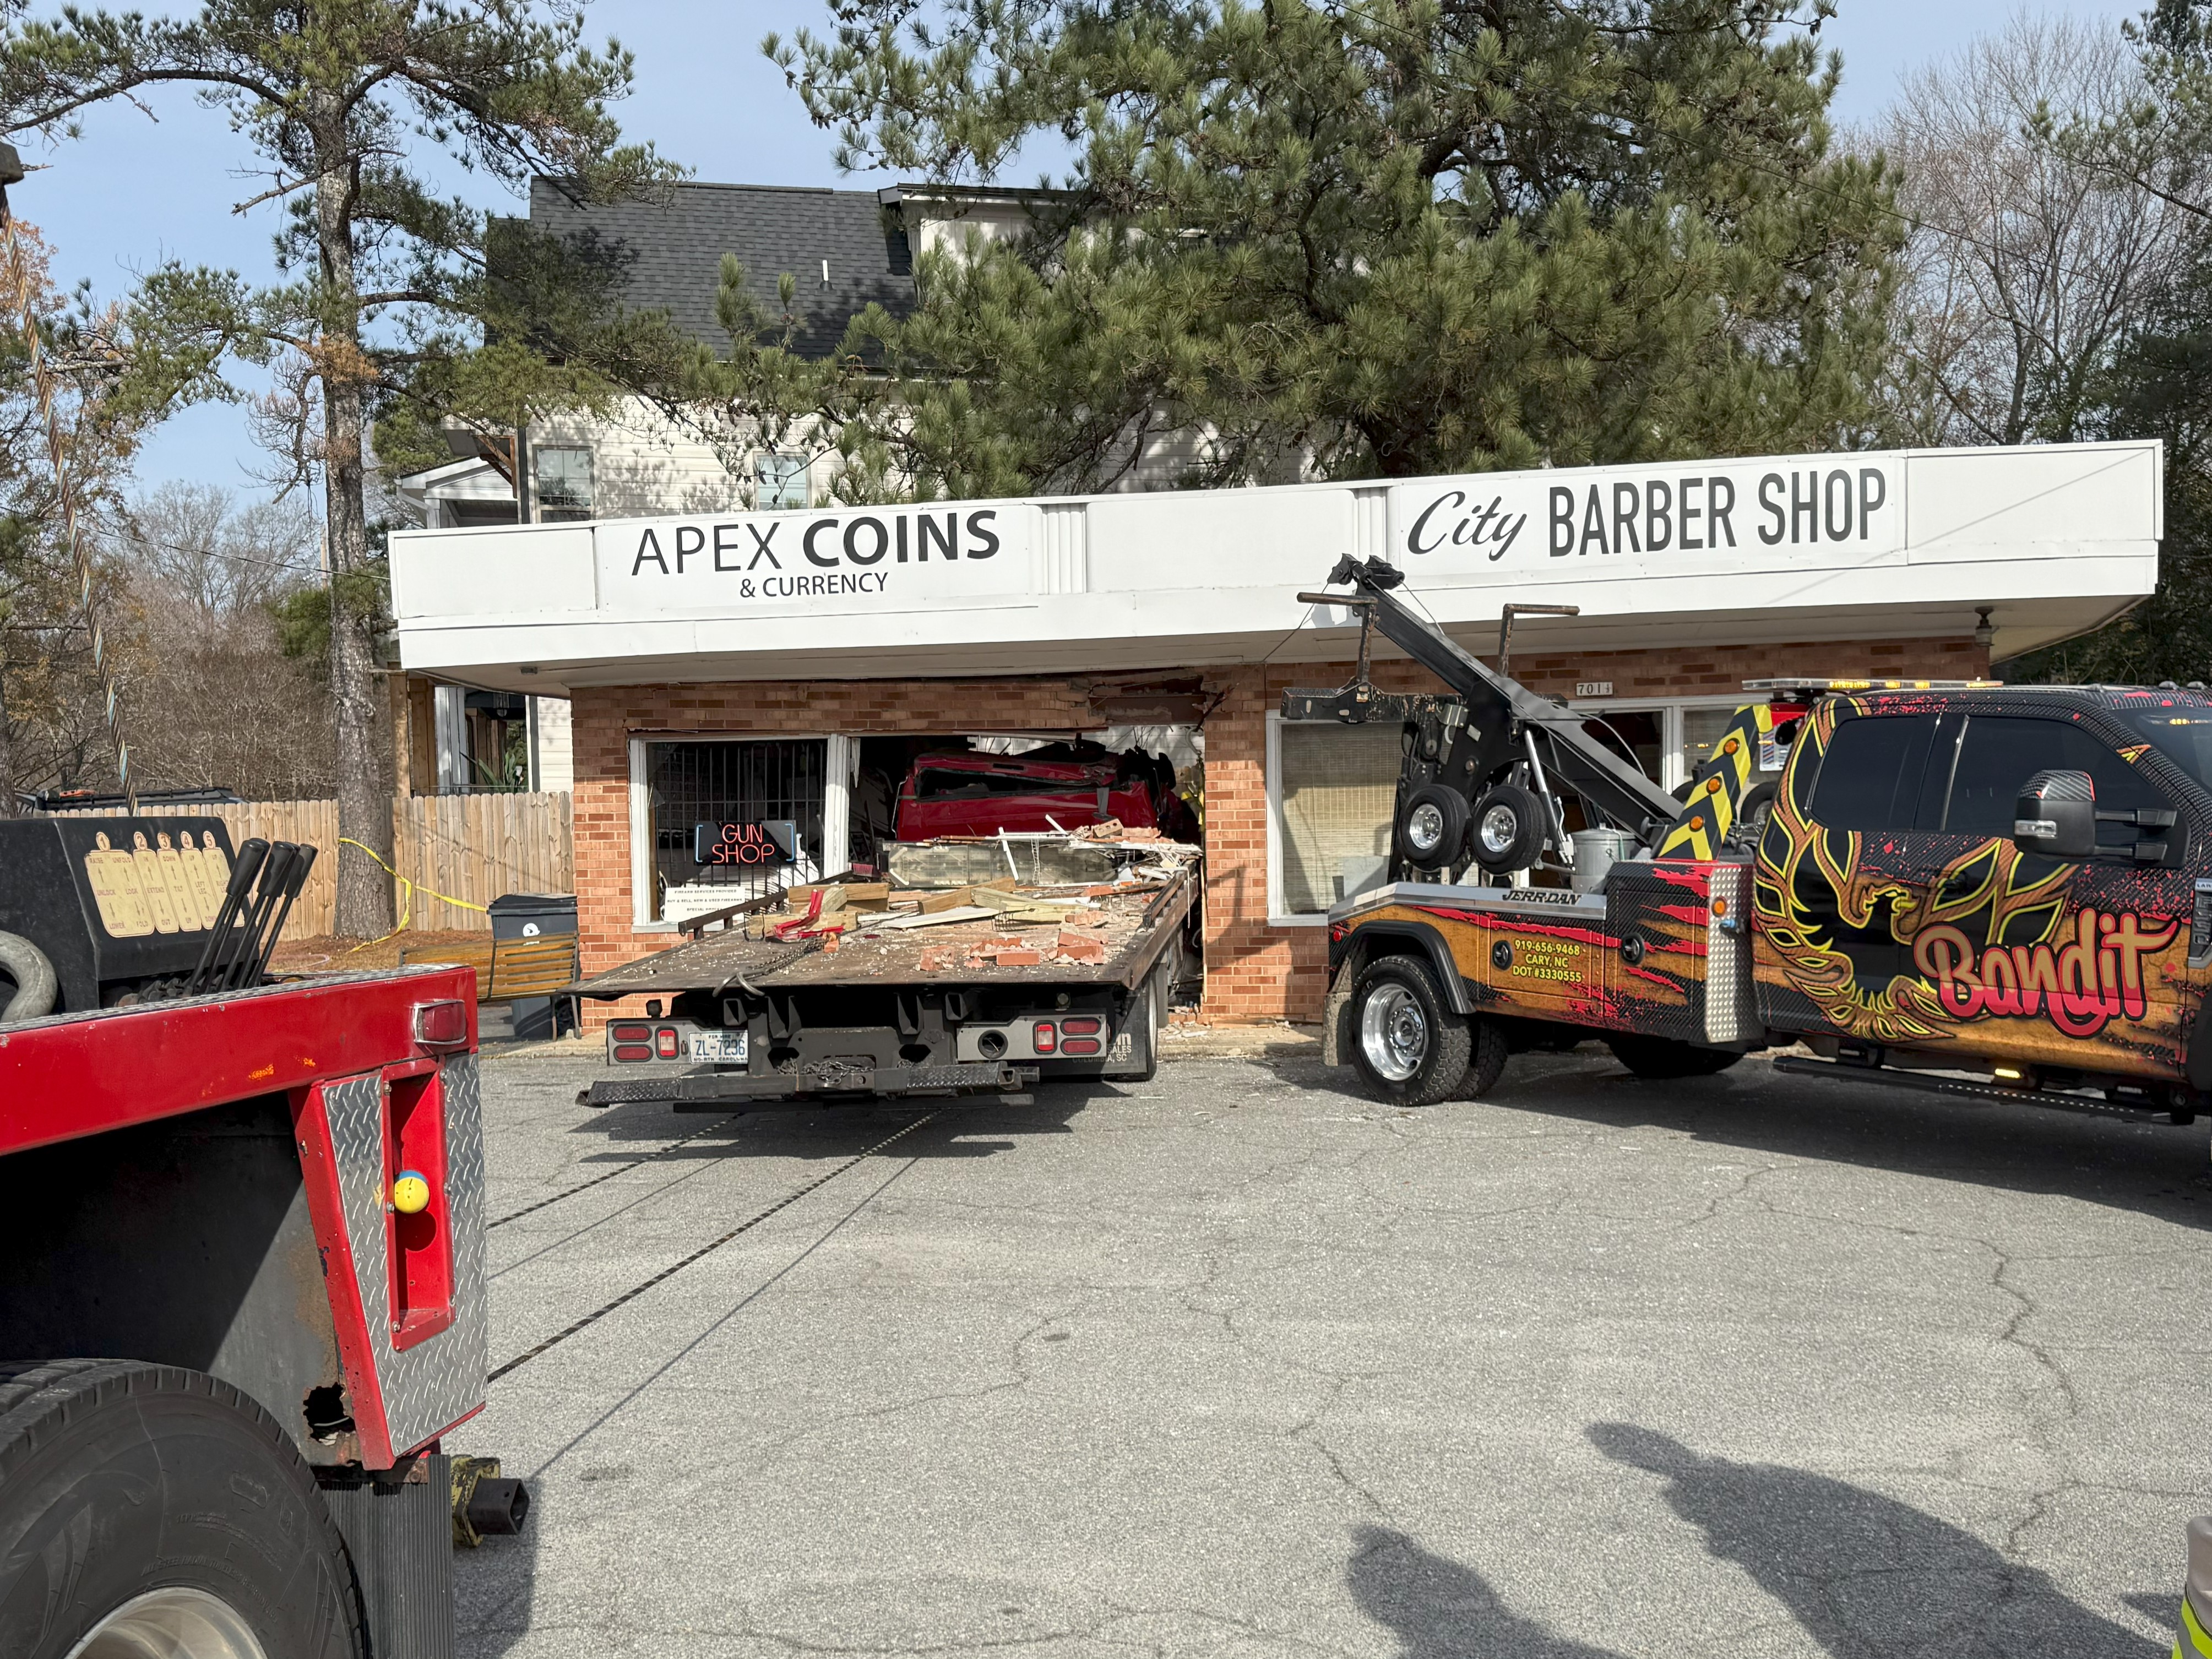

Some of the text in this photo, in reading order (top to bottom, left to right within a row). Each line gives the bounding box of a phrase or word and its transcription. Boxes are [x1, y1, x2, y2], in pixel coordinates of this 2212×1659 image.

[1407, 468, 1886, 561] City BARBER SHOP
[632, 510, 999, 576] APEX COINS
[740, 572, 888, 598] & CURRENCY
[100, 836, 106, 848] 1
[137, 835, 145, 847] 2
[161, 835, 167, 847] 3
[184, 835, 190, 846] 4
[206, 835, 213, 846] 5
[722, 824, 763, 844] GUN
[712, 844, 775, 863] SHOP
[1515, 939, 1580, 956] 919-656-9468
[1525, 954, 1569, 968] CARY, NC
[1513, 965, 1582, 983] DOT #3330555
[1913, 907, 2178, 1037] Bandit
[695, 1040, 745, 1056] ZL-7236
[1116, 1053, 1127, 1062] SC
